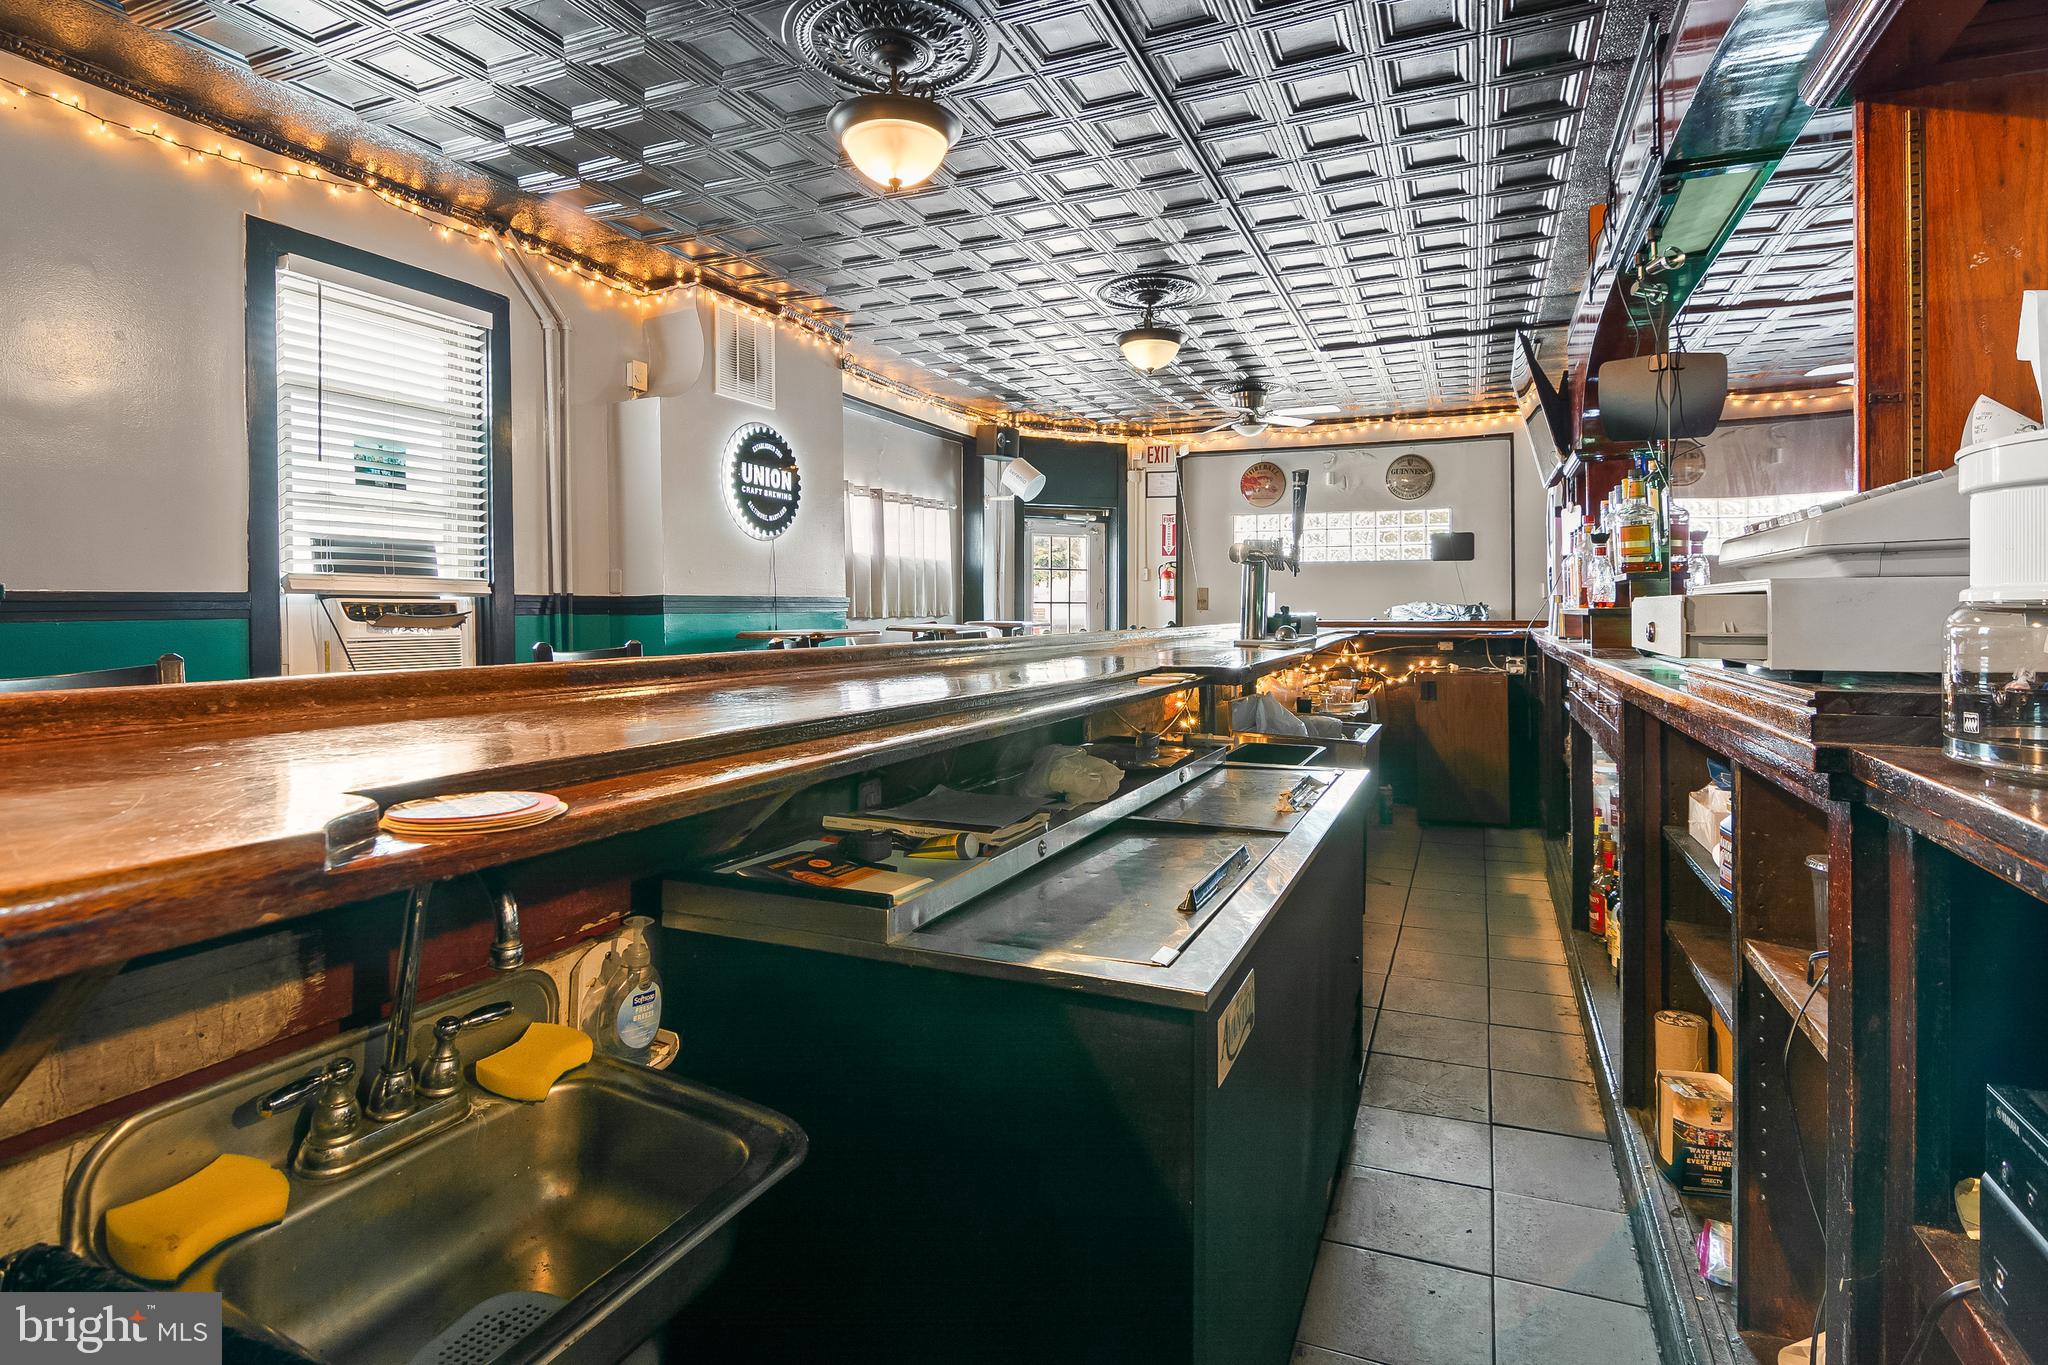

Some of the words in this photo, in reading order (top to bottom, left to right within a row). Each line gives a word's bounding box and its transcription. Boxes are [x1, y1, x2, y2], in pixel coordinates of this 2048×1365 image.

[1147, 445, 1171, 464] EXIT
[741, 461, 792, 491] UNION
[741, 485, 763, 496] CRAFT
[763, 490, 793, 501] BREWING
